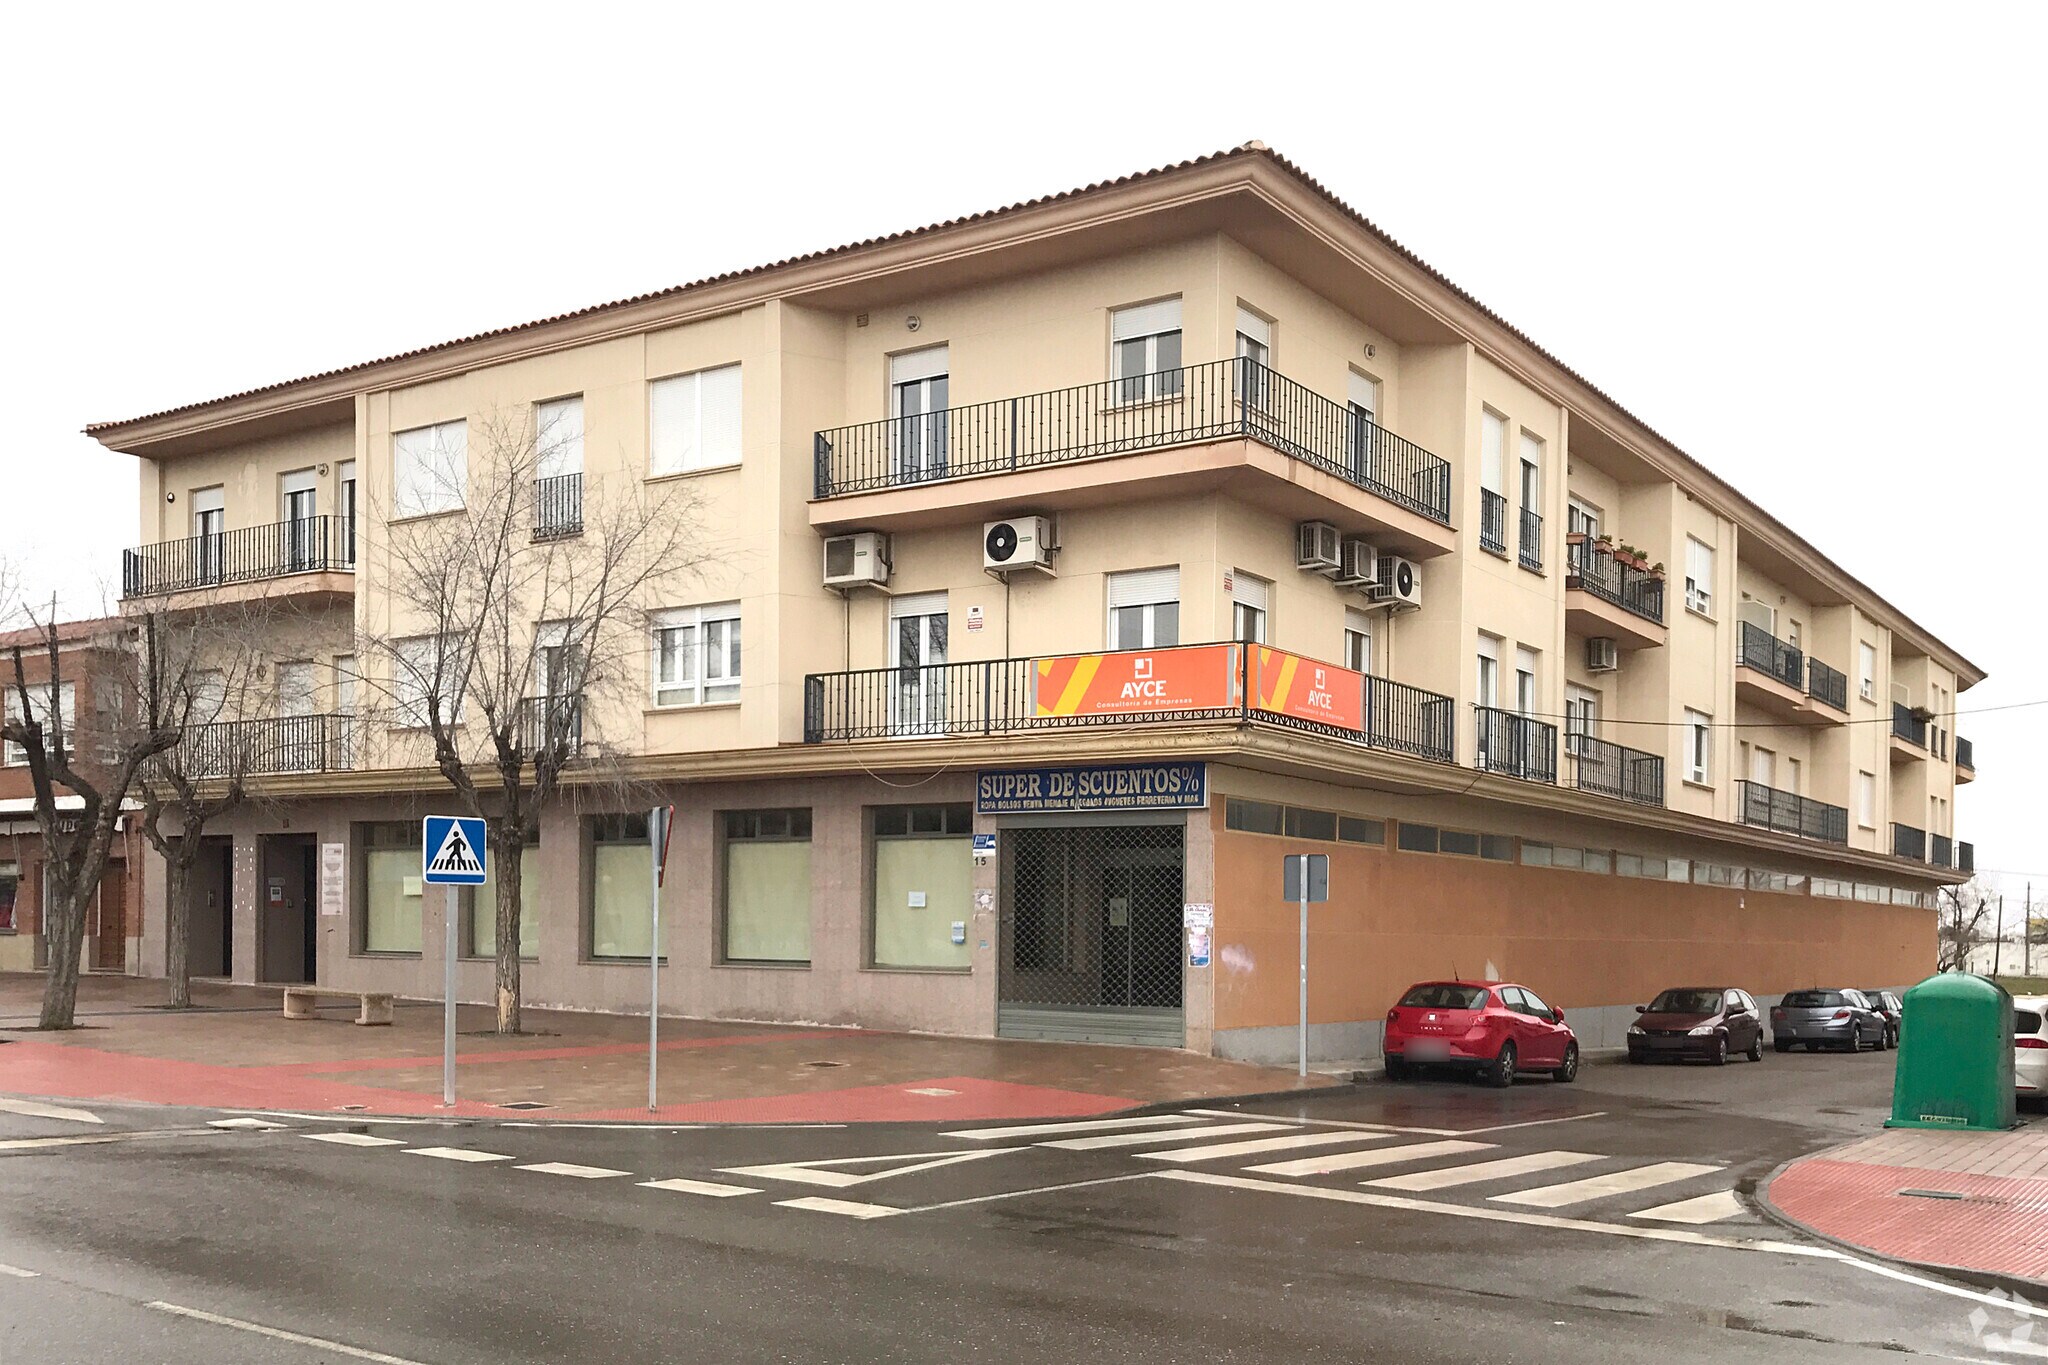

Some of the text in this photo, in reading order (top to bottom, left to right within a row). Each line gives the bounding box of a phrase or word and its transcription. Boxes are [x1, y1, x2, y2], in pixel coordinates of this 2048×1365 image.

[1120, 680, 1167, 698] AYCE
[1155, 698, 1193, 706] Empresas
[1307, 689, 1333, 710] AYCE
[980, 773, 1042, 799] SUPER
[980, 801, 996, 810] ROPA
[974, 856, 987, 866] 15
